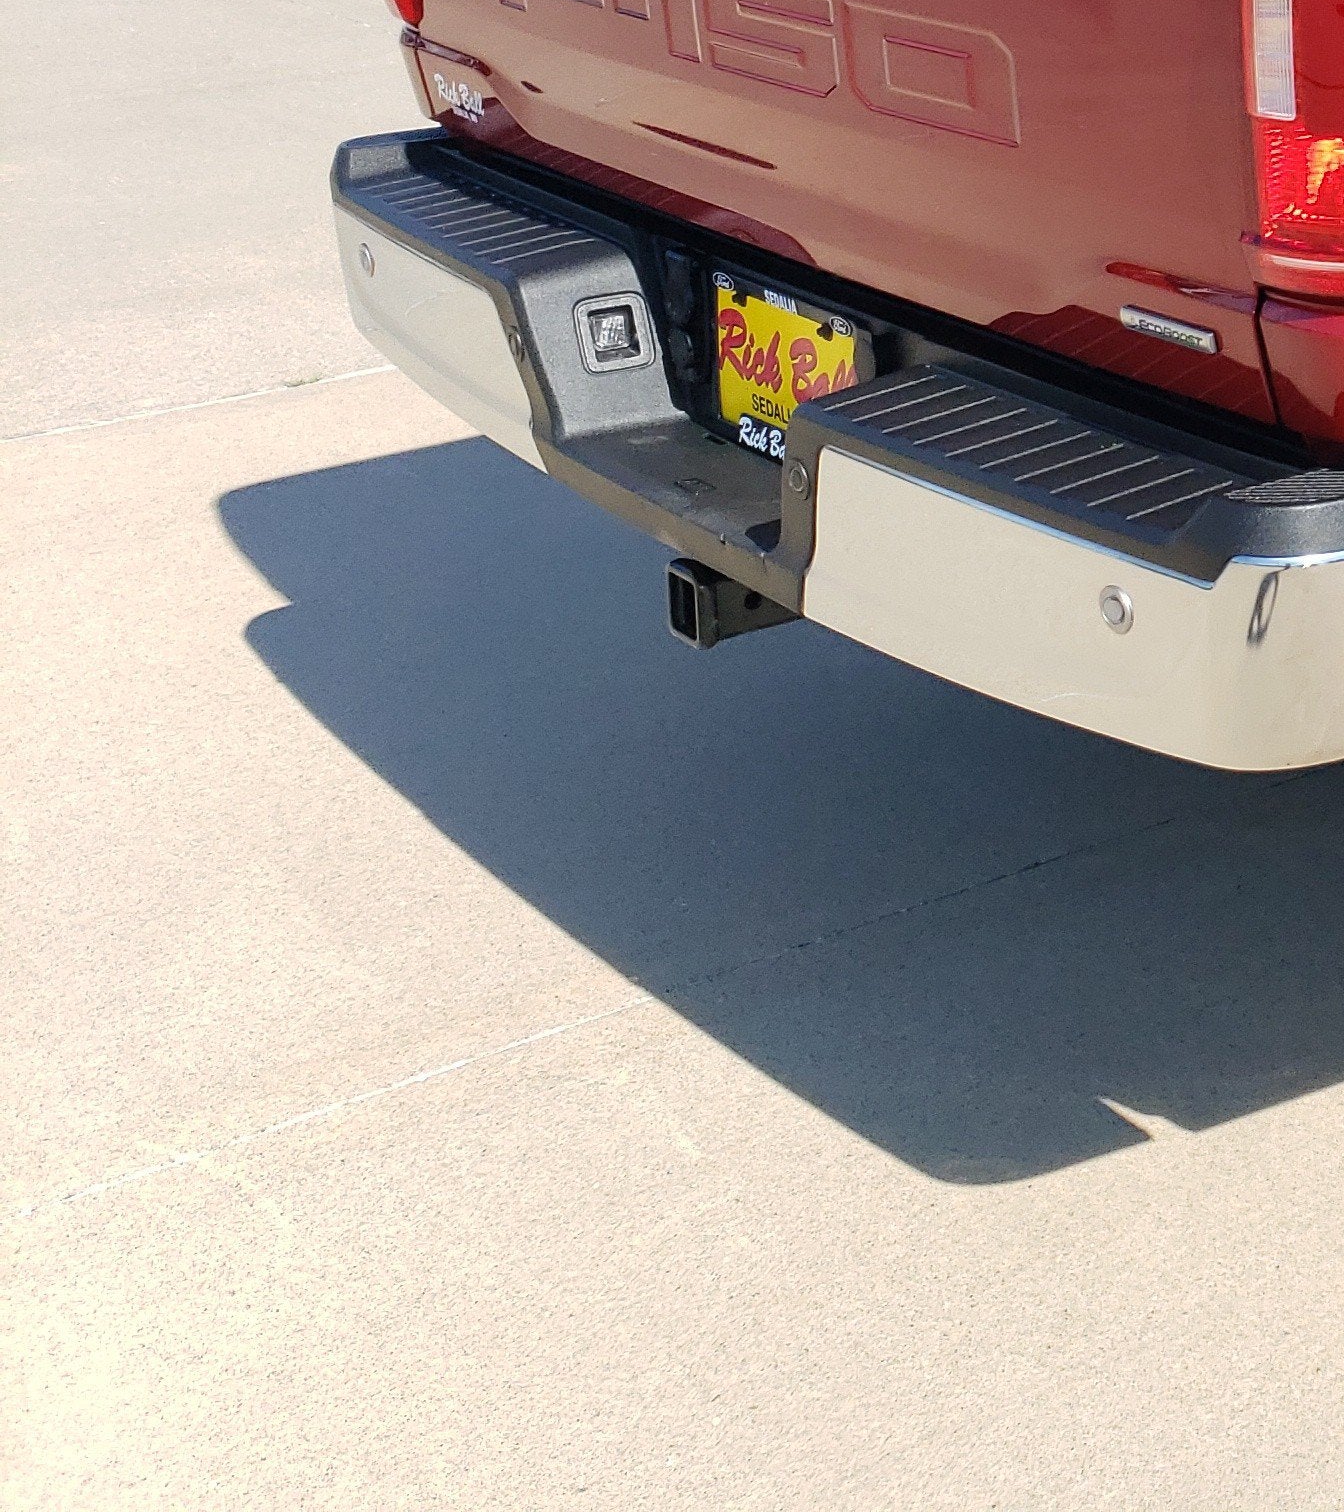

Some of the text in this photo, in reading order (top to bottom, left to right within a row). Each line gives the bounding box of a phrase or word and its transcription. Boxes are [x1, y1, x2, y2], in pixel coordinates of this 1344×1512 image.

[763, 289, 798, 316] SEDALIA
[719, 308, 783, 394] Rick
[751, 392, 791, 425] SEDALI
[738, 416, 786, 461] Rick Ba
